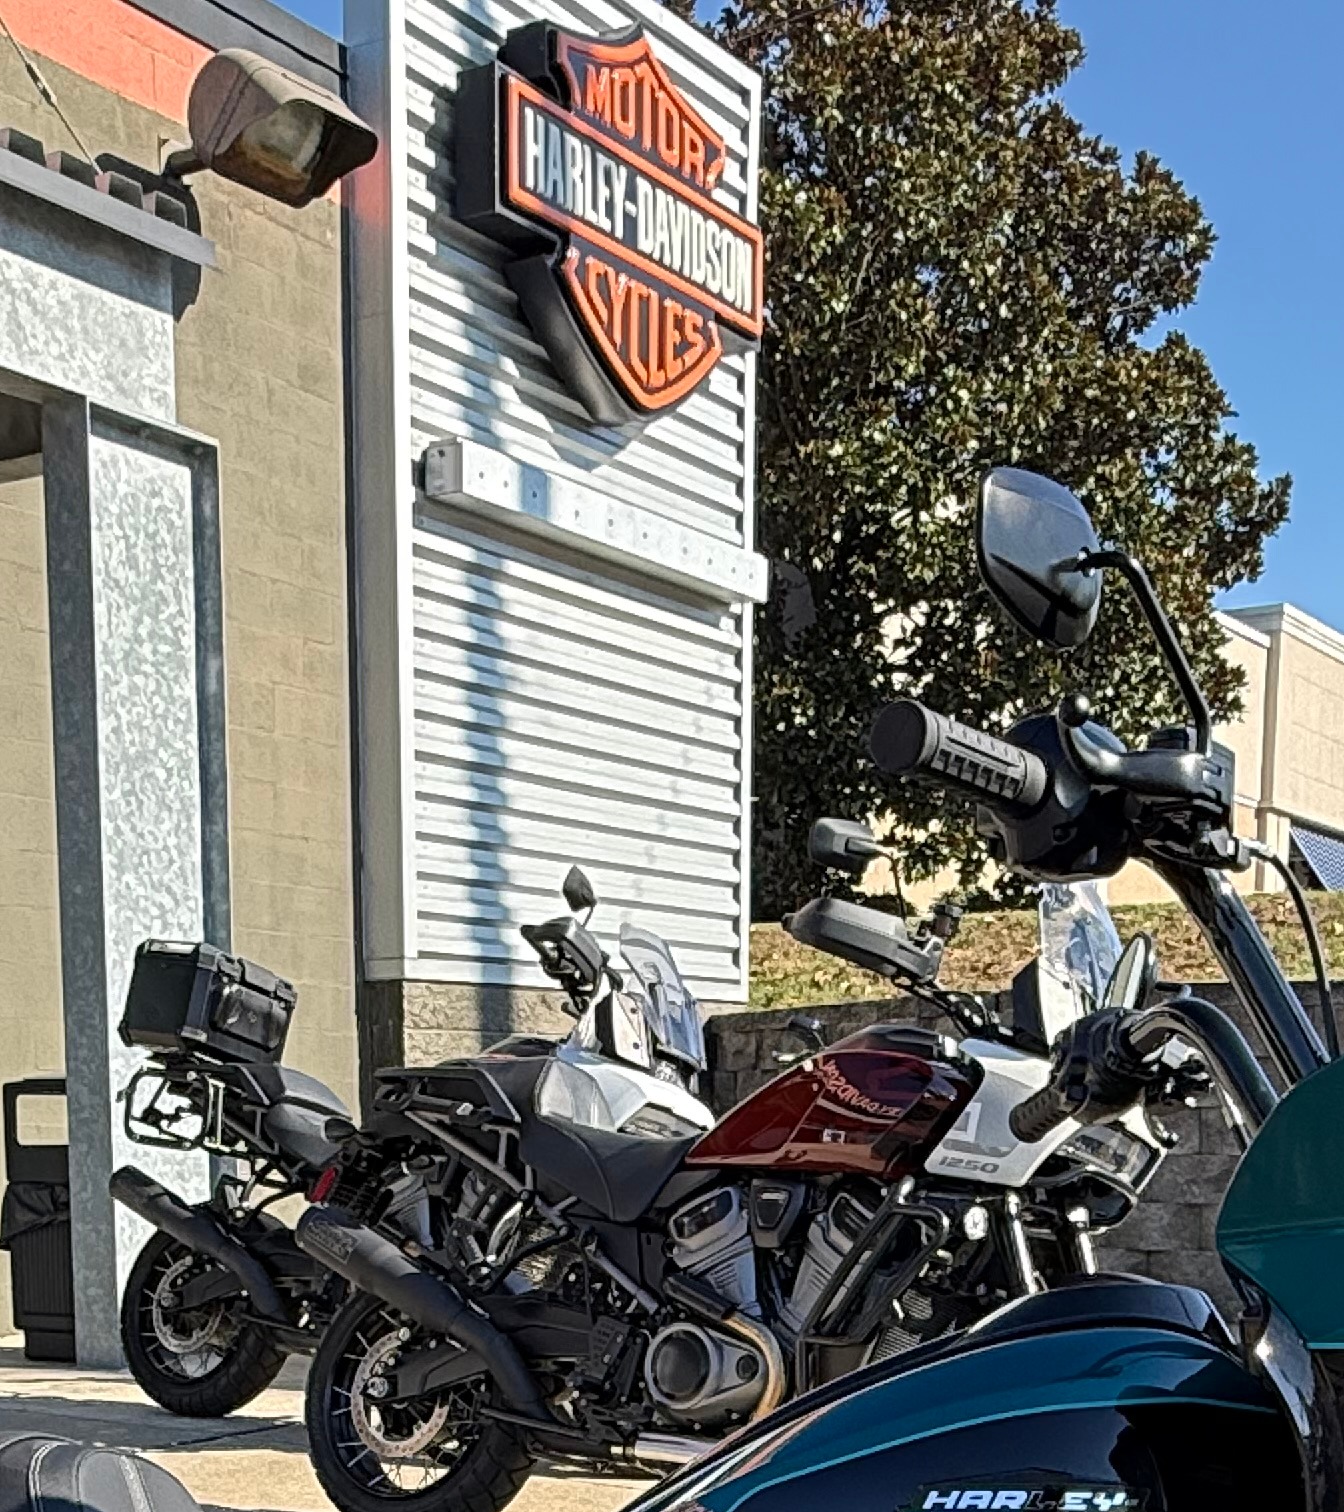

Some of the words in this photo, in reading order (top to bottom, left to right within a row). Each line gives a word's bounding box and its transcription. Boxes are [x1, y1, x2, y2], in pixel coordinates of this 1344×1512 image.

[586, 63, 706, 186] MOTOR
[525, 106, 752, 314] HARLEY-DAVIDSON
[585, 255, 707, 388] CYCLES
[938, 1156, 1000, 1174] 1250
